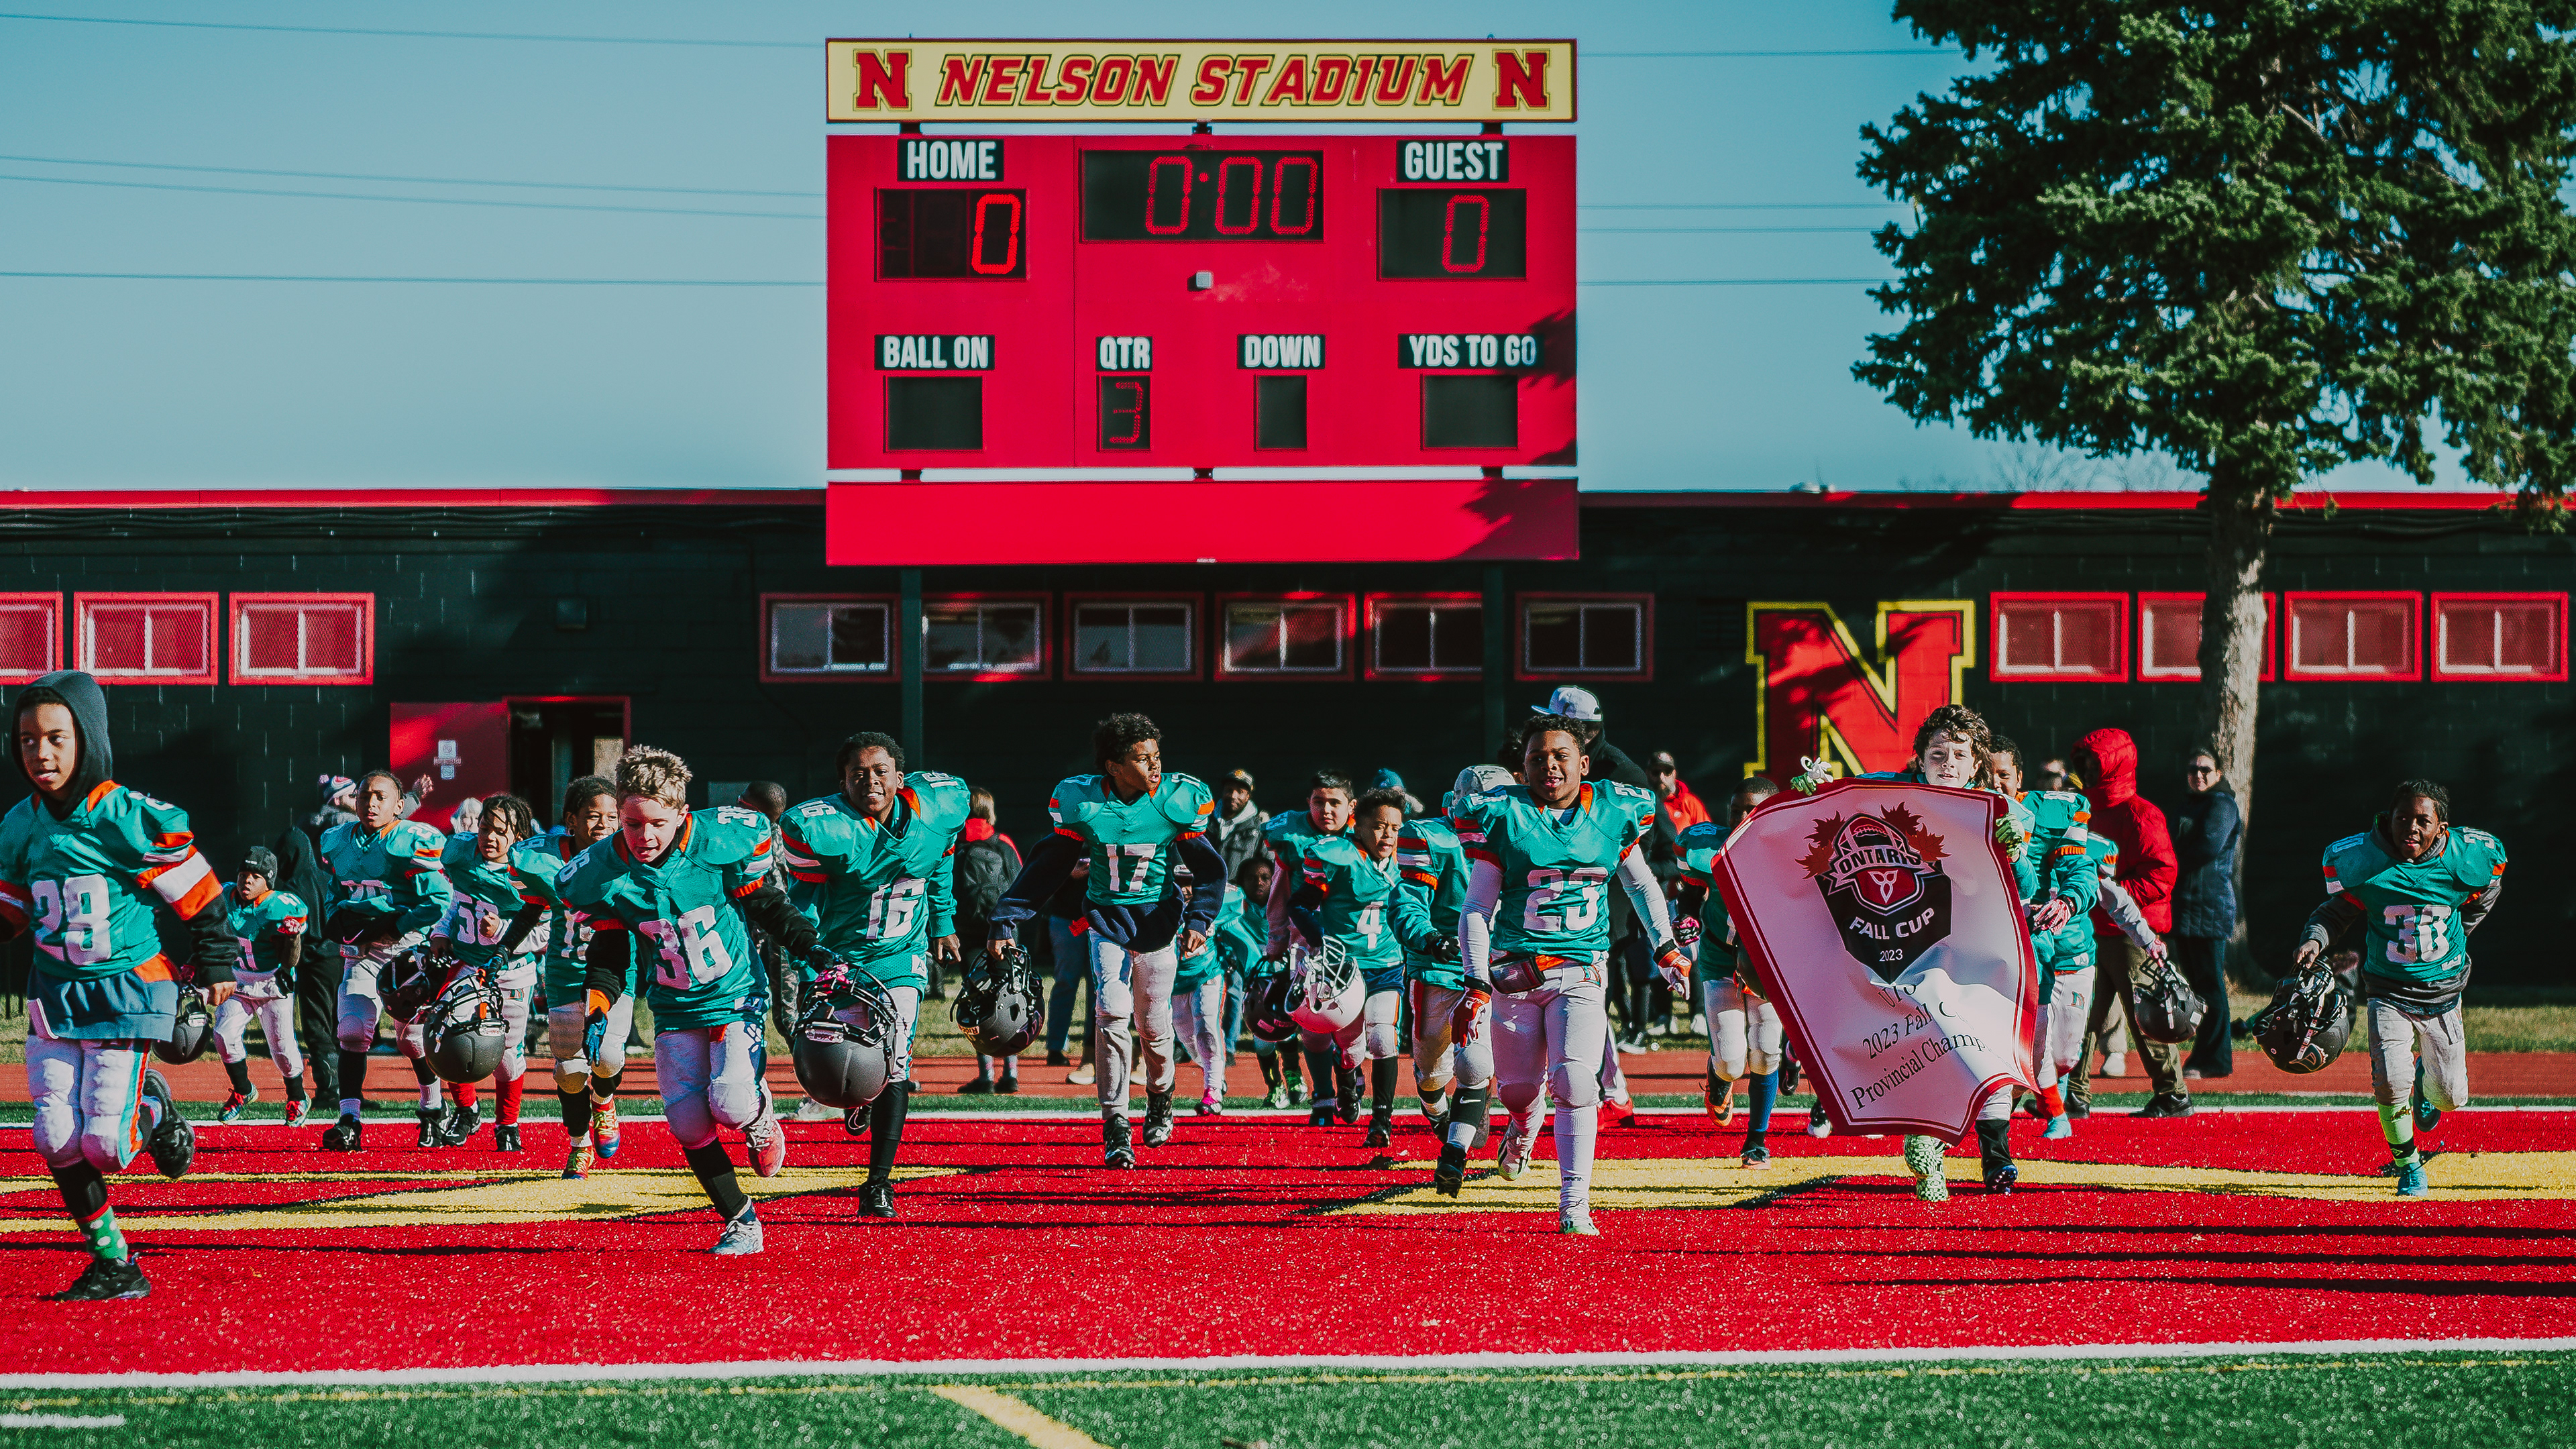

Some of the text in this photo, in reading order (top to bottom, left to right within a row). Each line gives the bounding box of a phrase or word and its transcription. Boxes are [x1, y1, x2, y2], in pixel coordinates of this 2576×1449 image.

[853, 49, 1550, 111] N NELSON STADIUM N
[907, 141, 996, 179] HOME
[1405, 142, 1503, 180] GUEST
[1145, 156, 1318, 235] 0:00
[971, 193, 1021, 274] 0
[1442, 195, 1489, 274] 0
[883, 336, 988, 368] BALL ON
[1099, 337, 1150, 370] QTR
[1244, 335, 1321, 368] DOWN
[1409, 335, 1537, 367] YDS TO GO
[1109, 381, 1144, 444] 3
[1744, 600, 1976, 790] N
[1106, 843, 1157, 892] 17
[866, 877, 926, 939] 16
[1356, 901, 1384, 943] 4
[1849, 908, 1935, 940] FALL CUP
[639, 905, 733, 989] 36
[1879, 949, 1903, 962] 2023
[1862, 1022, 1899, 1059] 2023
[1904, 1002, 1933, 1036] Fall
[1849, 1033, 2015, 1110] Provincial Champ
